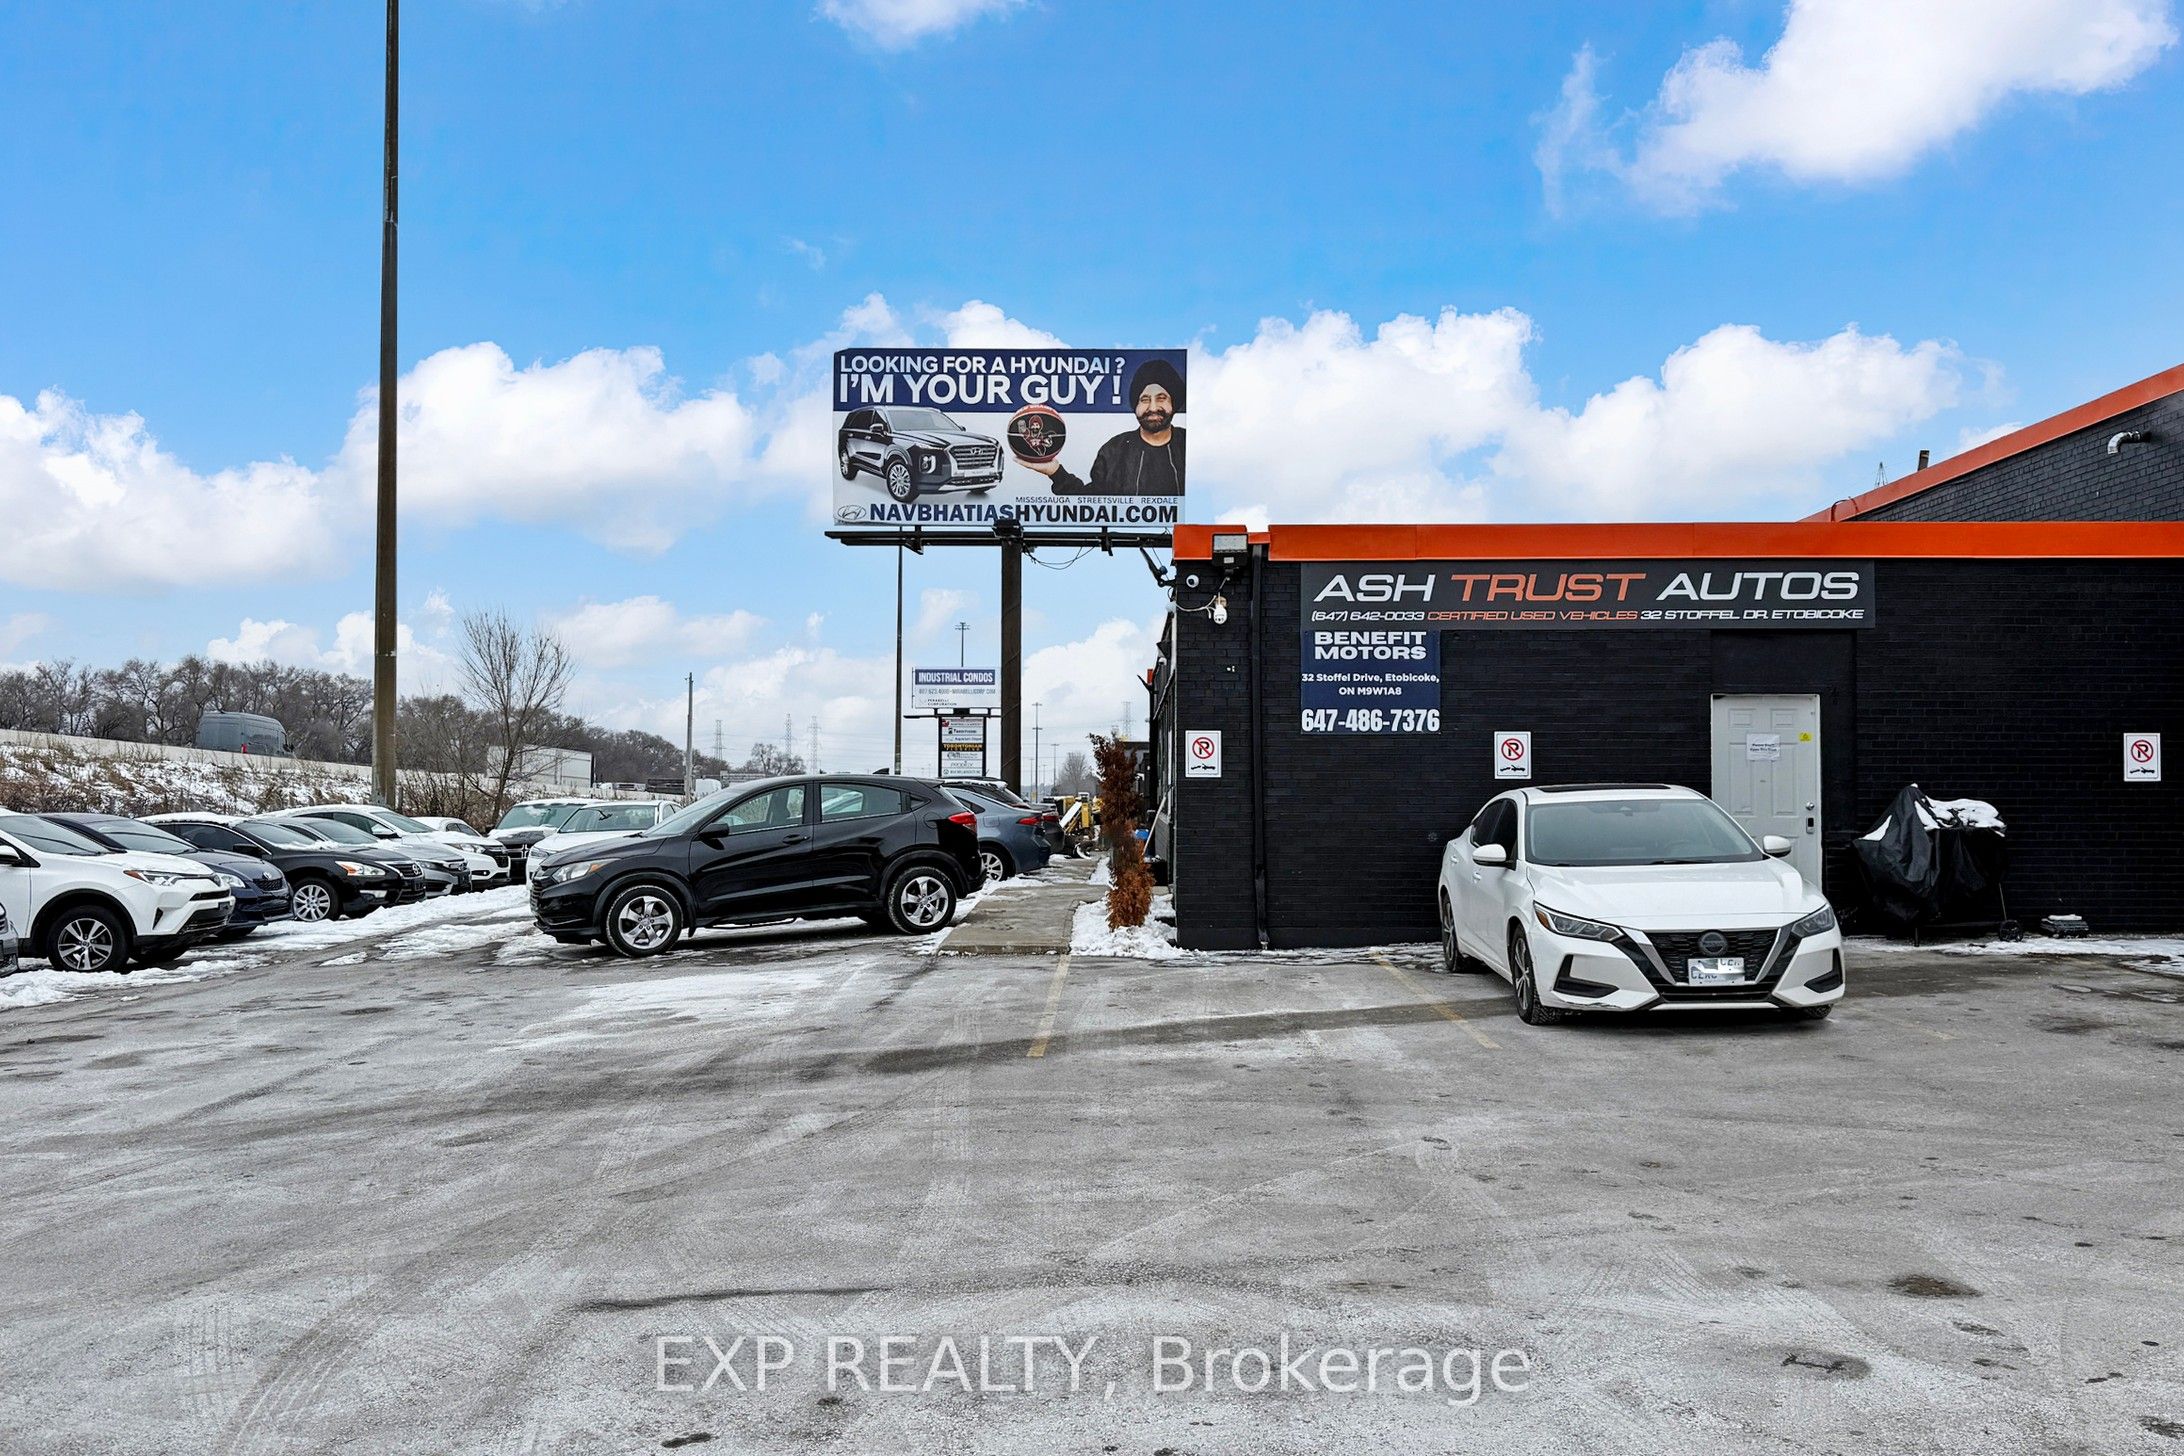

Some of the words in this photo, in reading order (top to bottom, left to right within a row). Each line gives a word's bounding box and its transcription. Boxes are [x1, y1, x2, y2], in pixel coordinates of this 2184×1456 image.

[840, 356, 938, 374] LOOKING
[943, 356, 986, 374] FOR
[990, 356, 1010, 374] A
[1010, 357, 1110, 374] HYUNDAI
[839, 375, 894, 404] I'M
[900, 375, 1013, 404] YOUR
[1020, 375, 1107, 405] GUY
[1016, 496, 1071, 504] MISSISSAUGA
[1077, 496, 1134, 504] STREETSVILLE
[870, 503, 1178, 523] NAVBHATIASHYUNDAI.COM
[1314, 574, 1436, 602] ASH
[1451, 573, 1647, 601] TRUST
[1656, 572, 1860, 601] AUTOS
[1311, 611, 1348, 622] (647)
[1350, 611, 1425, 621] 642-0033
[1427, 611, 1507, 621] CERTIFIED
[1511, 611, 1556, 621] USED
[1559, 611, 1637, 621] VEHICLES
[1640, 610, 1663, 620] 32
[1664, 610, 1739, 620] STOFFEL
[1772, 610, 1864, 620] ETOBICOKE
[1314, 631, 1426, 645] BENEFIT
[1314, 646, 1427, 660] MOTORS
[919, 672, 962, 682] INDUSTRIAL
[963, 672, 993, 682] CONDOS
[1301, 673, 1315, 682] 32
[1316, 673, 1351, 682] Stoffel
[1353, 673, 1383, 683] Drive,
[1385, 673, 1440, 683] Etobicoke,
[1338, 687, 1355, 695] ON
[1357, 687, 1402, 695] M9W1A8
[1301, 708, 1440, 732] 647-486-7376
